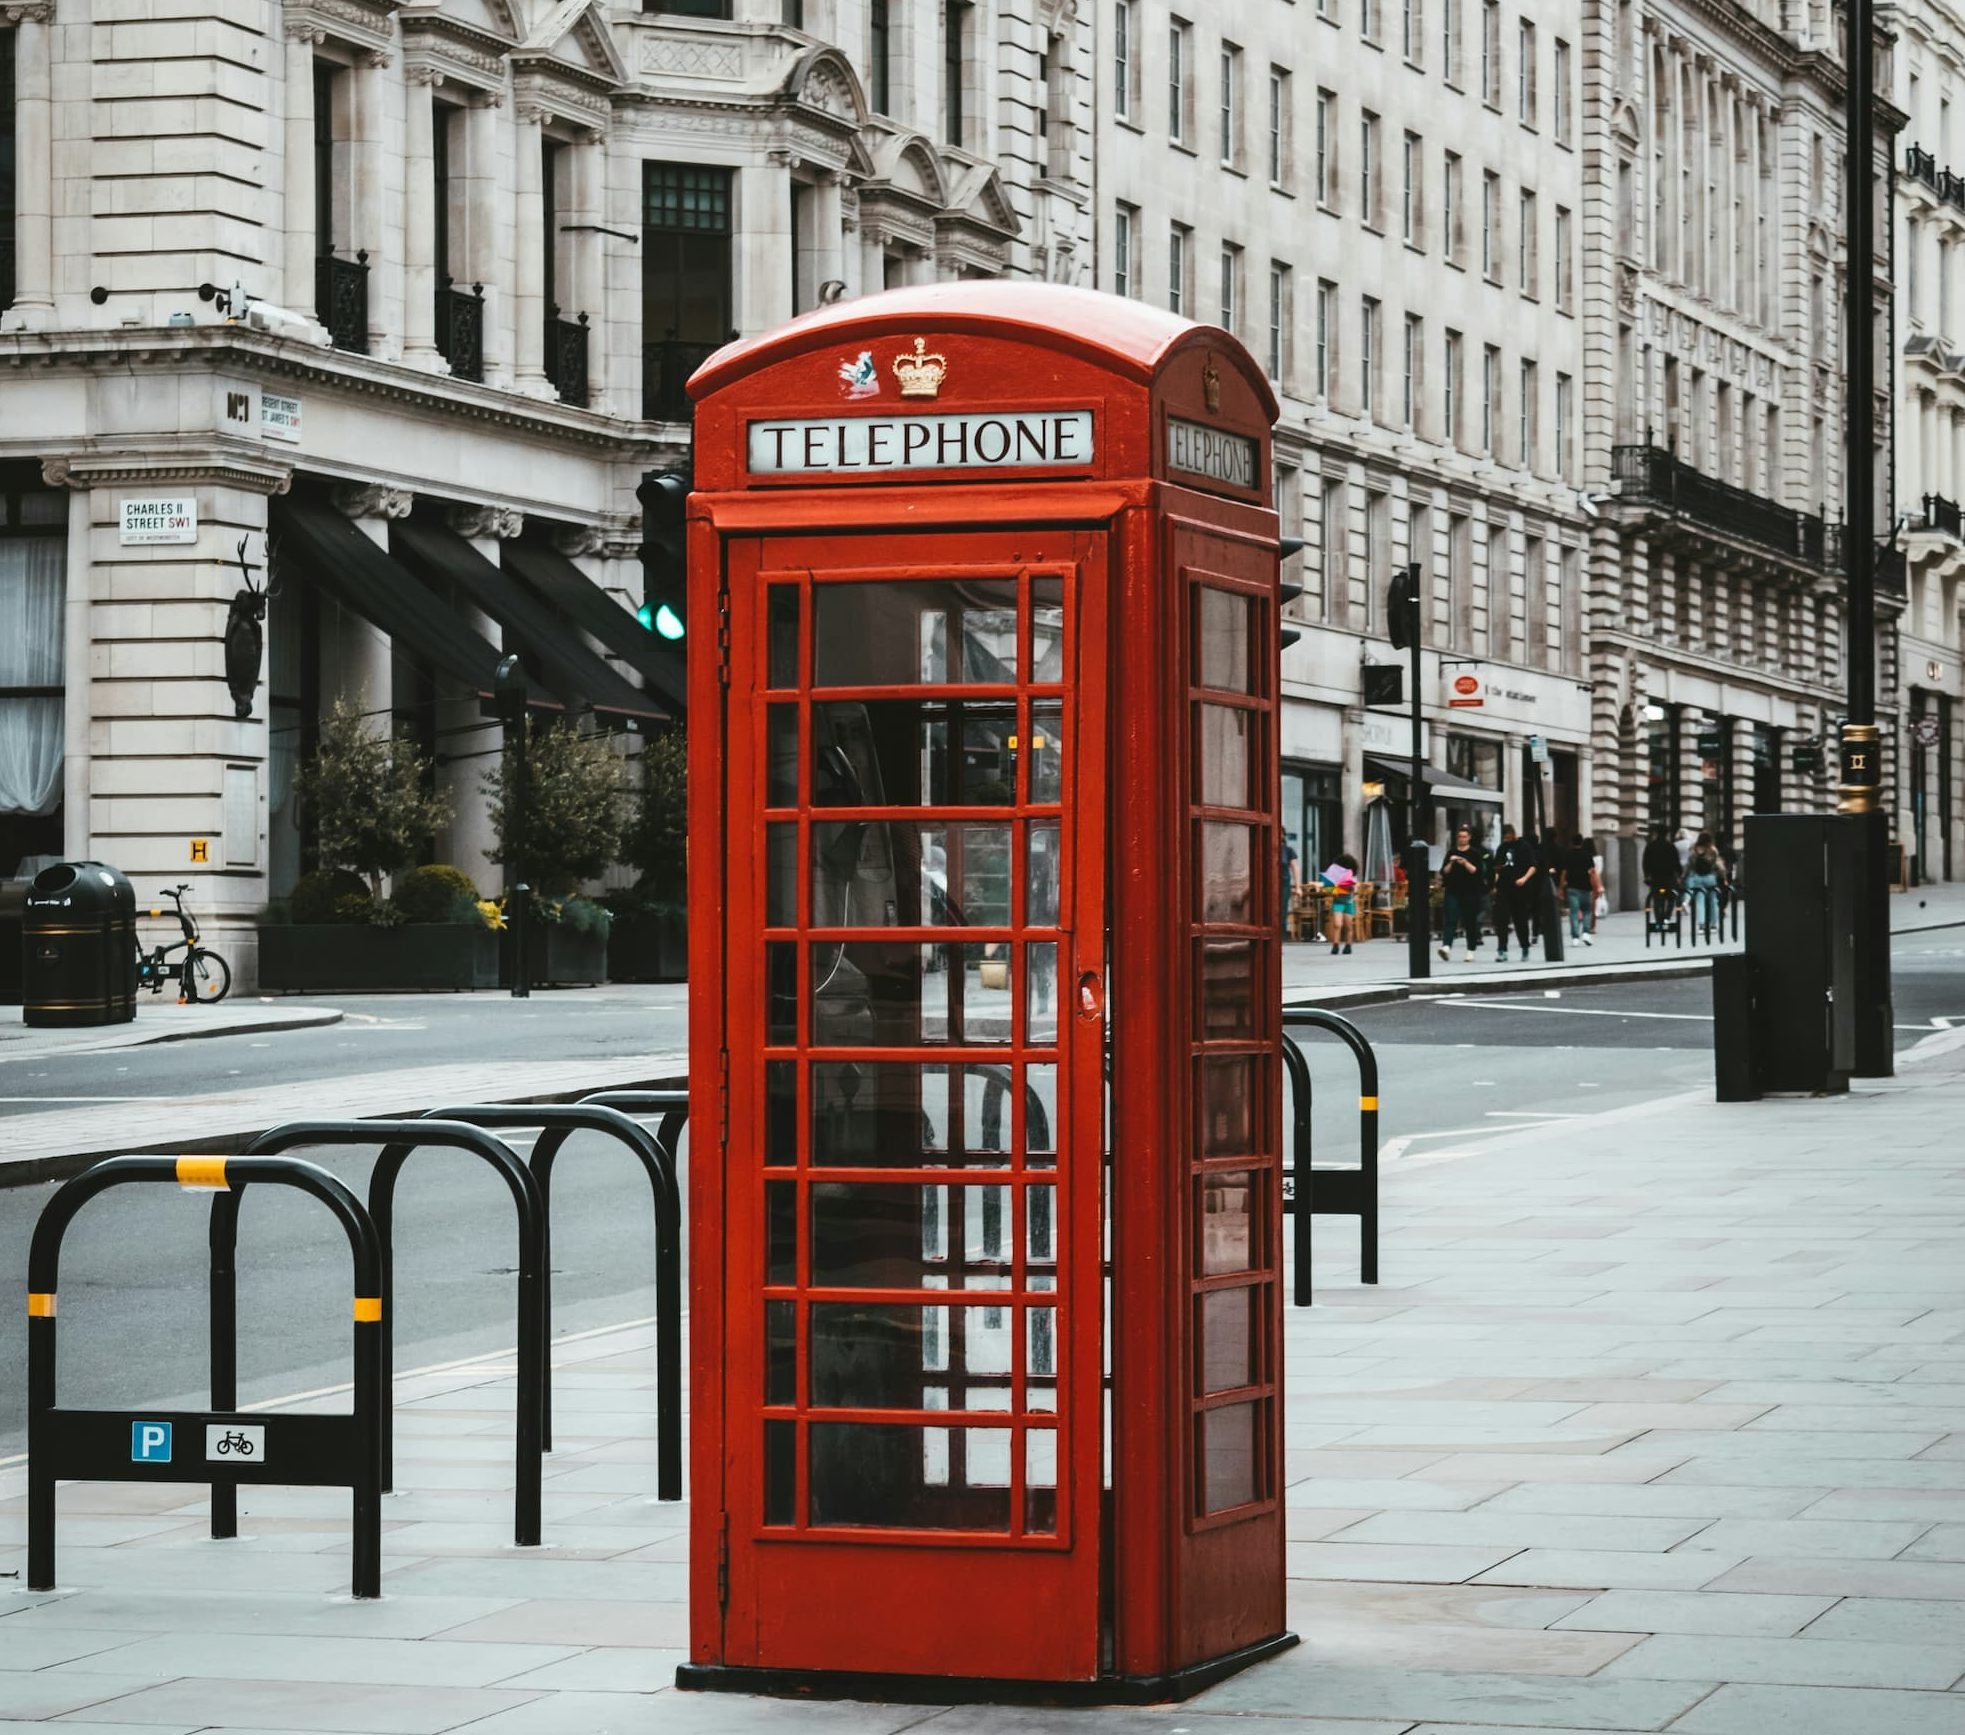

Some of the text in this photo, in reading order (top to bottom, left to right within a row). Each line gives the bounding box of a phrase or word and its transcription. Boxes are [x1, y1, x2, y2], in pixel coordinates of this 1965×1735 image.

[281, 400, 298, 413] STREET
[763, 418, 1079, 469] TELEPHONE
[127, 503, 183, 515] CHARLES II
[126, 517, 190, 529] STREET SW1
[193, 842, 206, 860] H
[142, 1426, 165, 1457] P
